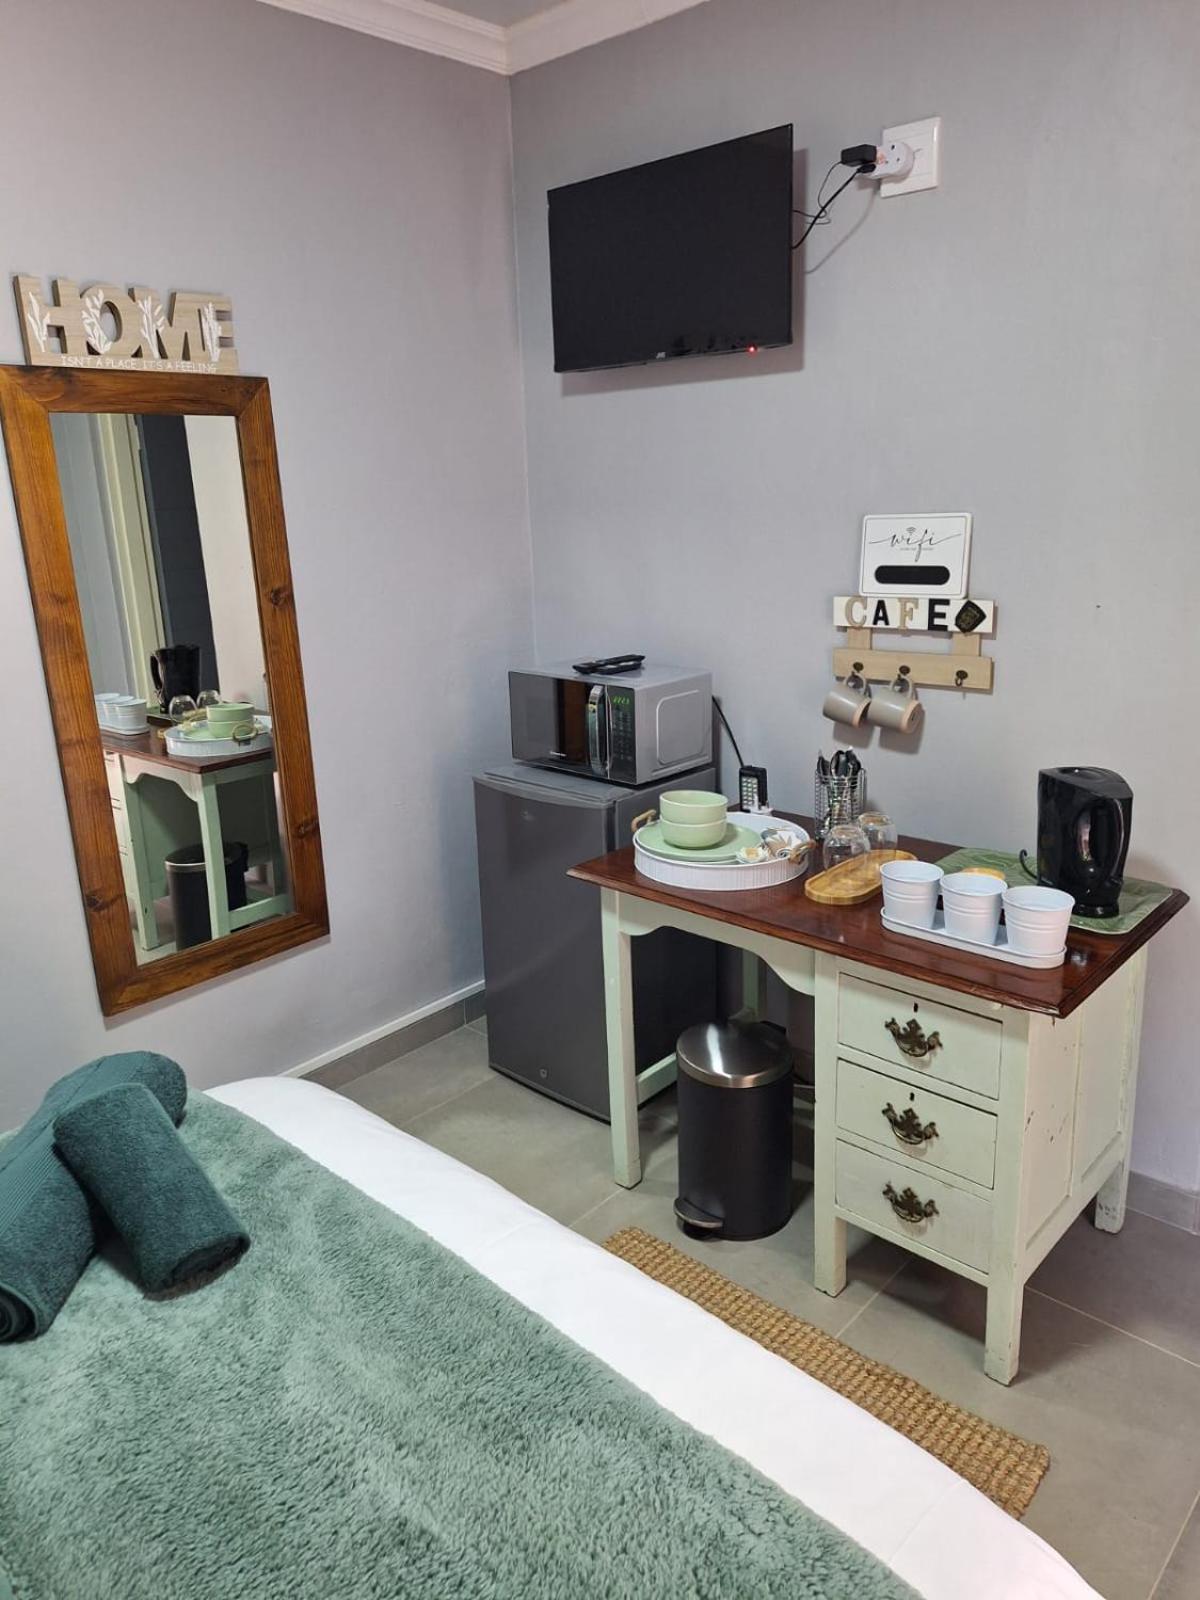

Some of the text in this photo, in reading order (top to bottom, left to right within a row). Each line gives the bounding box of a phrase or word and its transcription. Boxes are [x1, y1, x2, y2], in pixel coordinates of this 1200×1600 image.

[14, 275, 234, 363] HOME
[95, 357, 103, 368] A
[105, 358, 137, 369] PLACE
[166, 361, 172, 370] A
[175, 361, 217, 374] FEELING
[868, 527, 962, 562] wifi
[845, 596, 951, 633] CAFE
